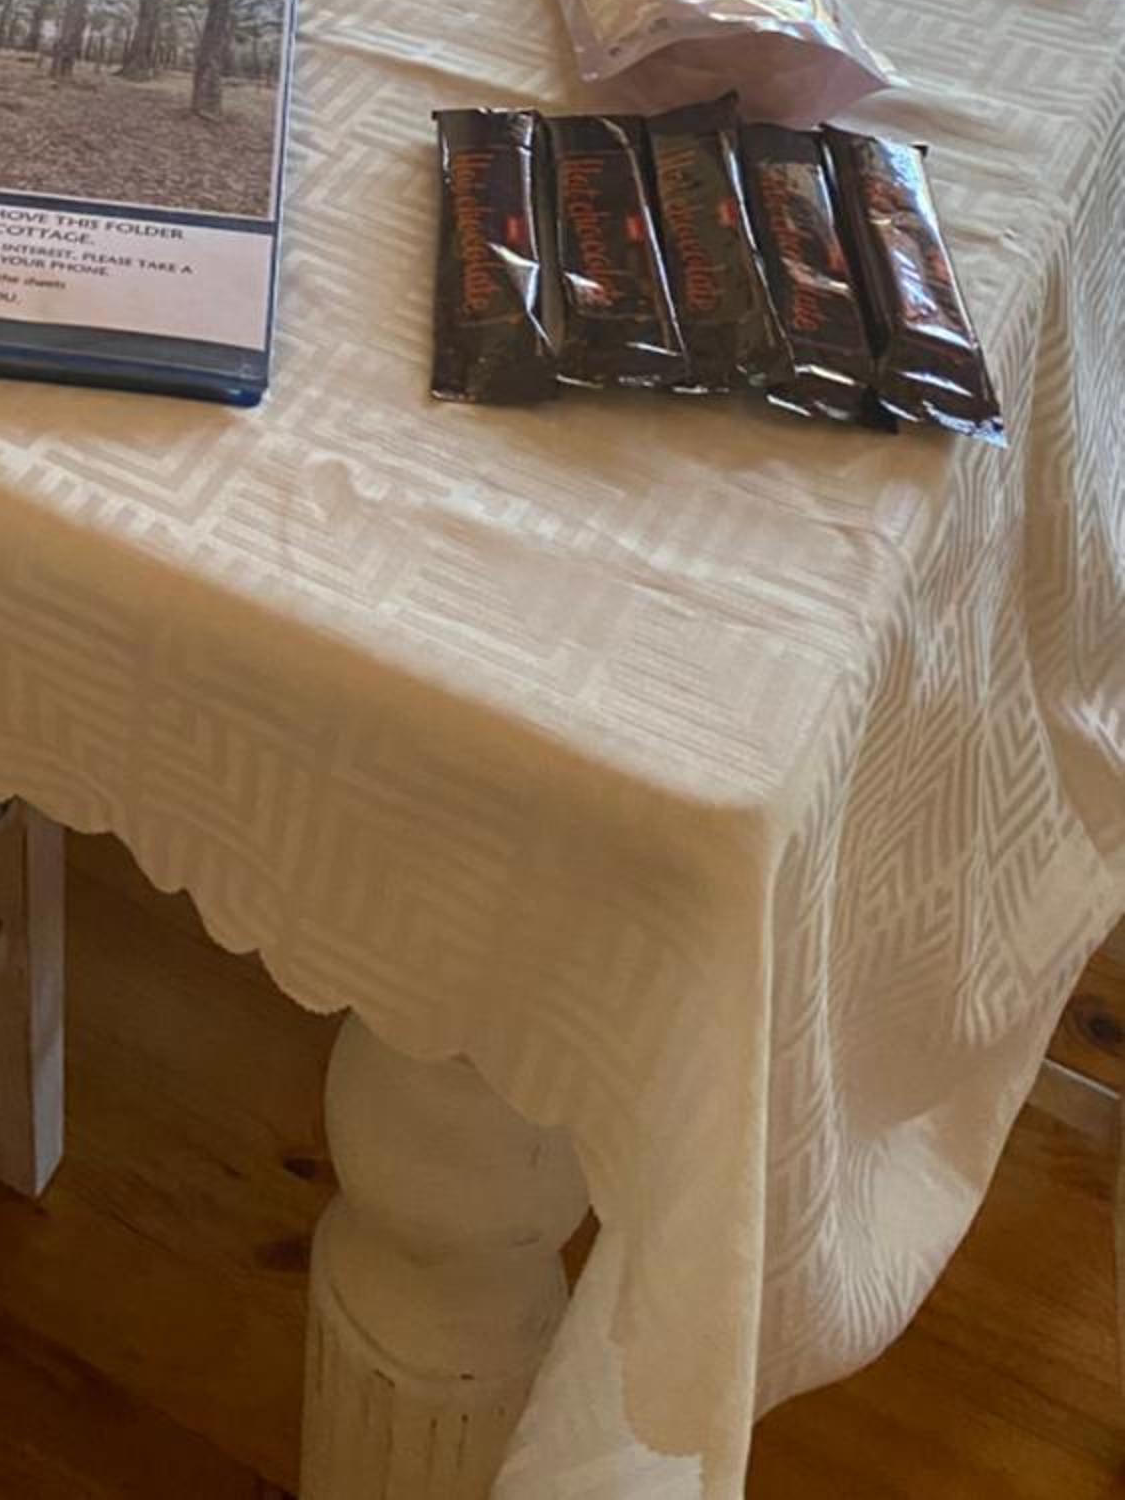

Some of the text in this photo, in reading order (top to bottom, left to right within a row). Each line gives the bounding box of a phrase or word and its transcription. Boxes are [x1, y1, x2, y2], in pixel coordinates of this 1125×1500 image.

[56, 215, 99, 231] THIS
[104, 220, 185, 240] FOLDER
[0, 254, 45, 269] YOUR
[82, 252, 132, 267] PLEASE
[138, 258, 175, 274] TAKE
[180, 264, 194, 274] A
